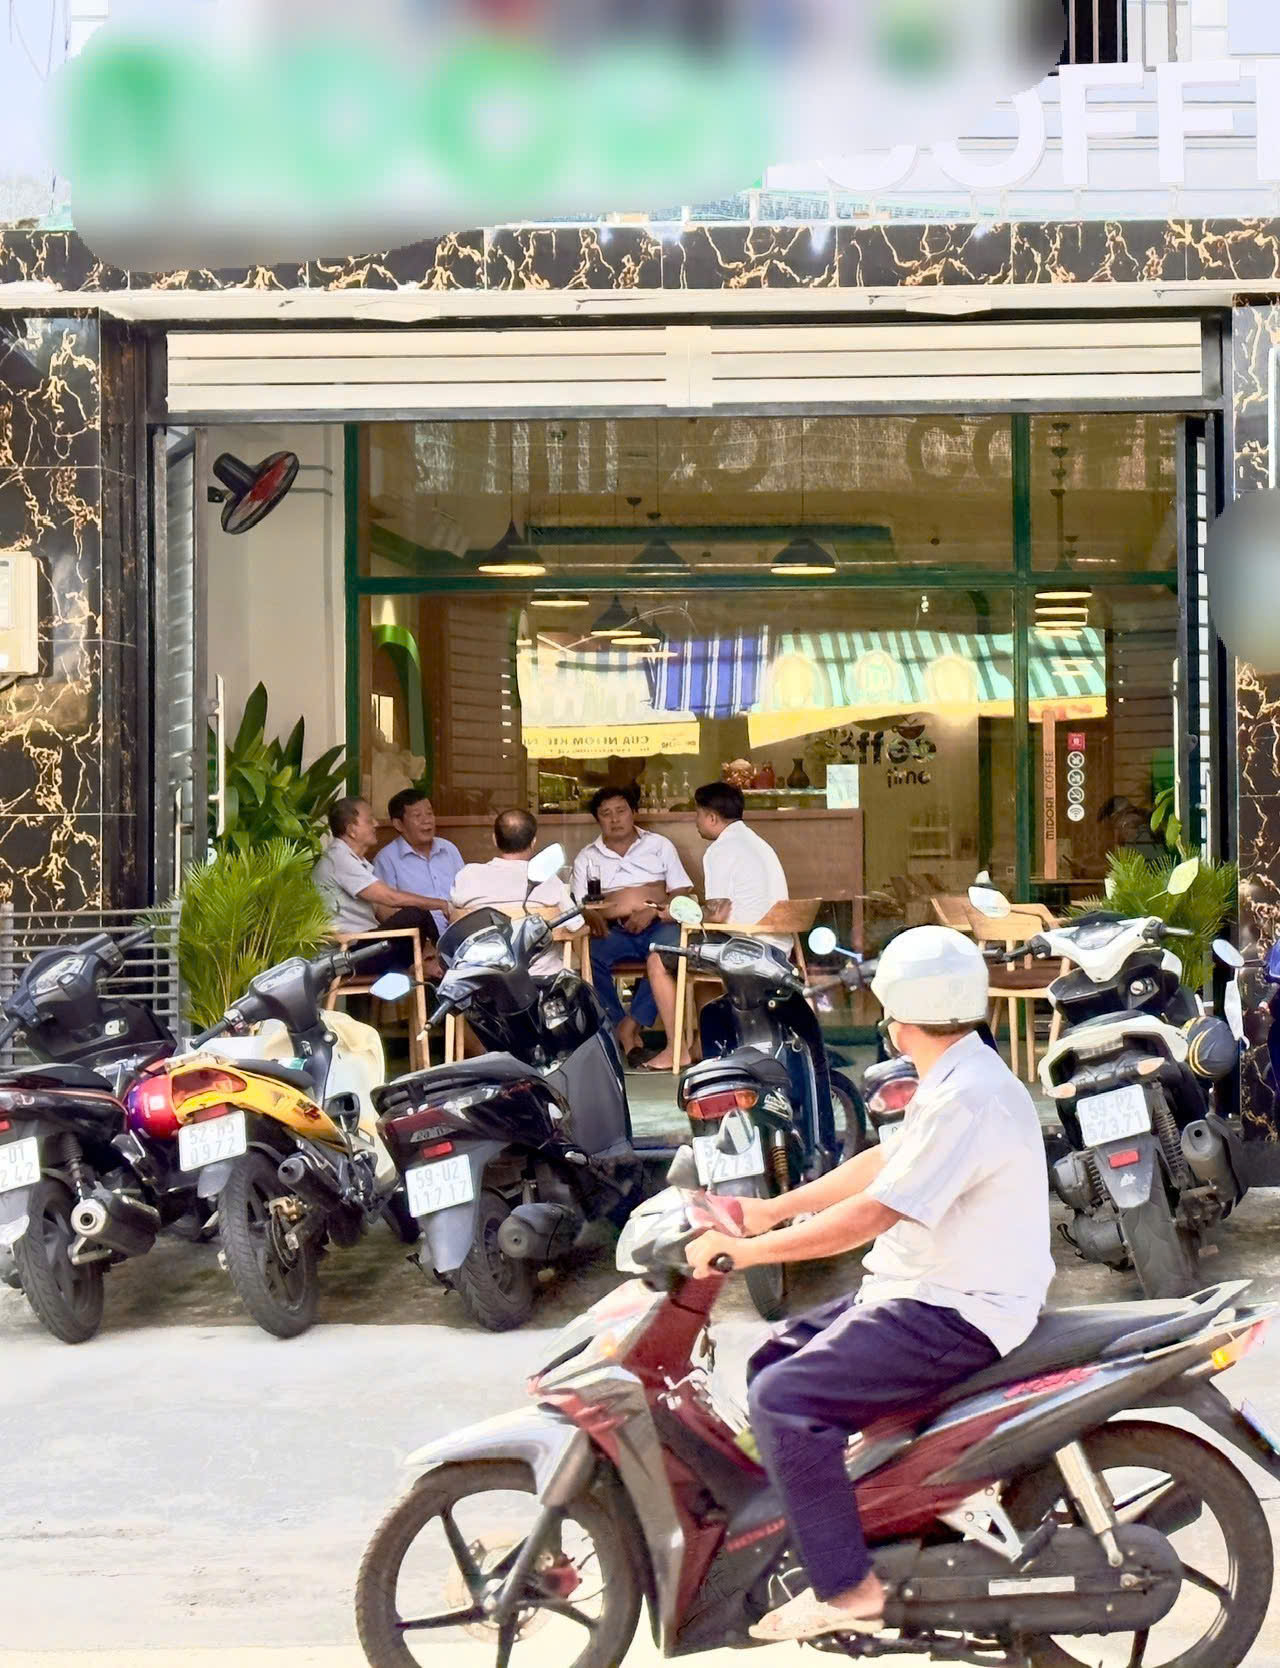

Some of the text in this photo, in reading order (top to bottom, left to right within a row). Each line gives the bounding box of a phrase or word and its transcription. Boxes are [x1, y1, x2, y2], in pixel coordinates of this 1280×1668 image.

[1044, 752, 1055, 840] MIDORI COFFEE
[416, 1160, 460, 1189] 59-U2
